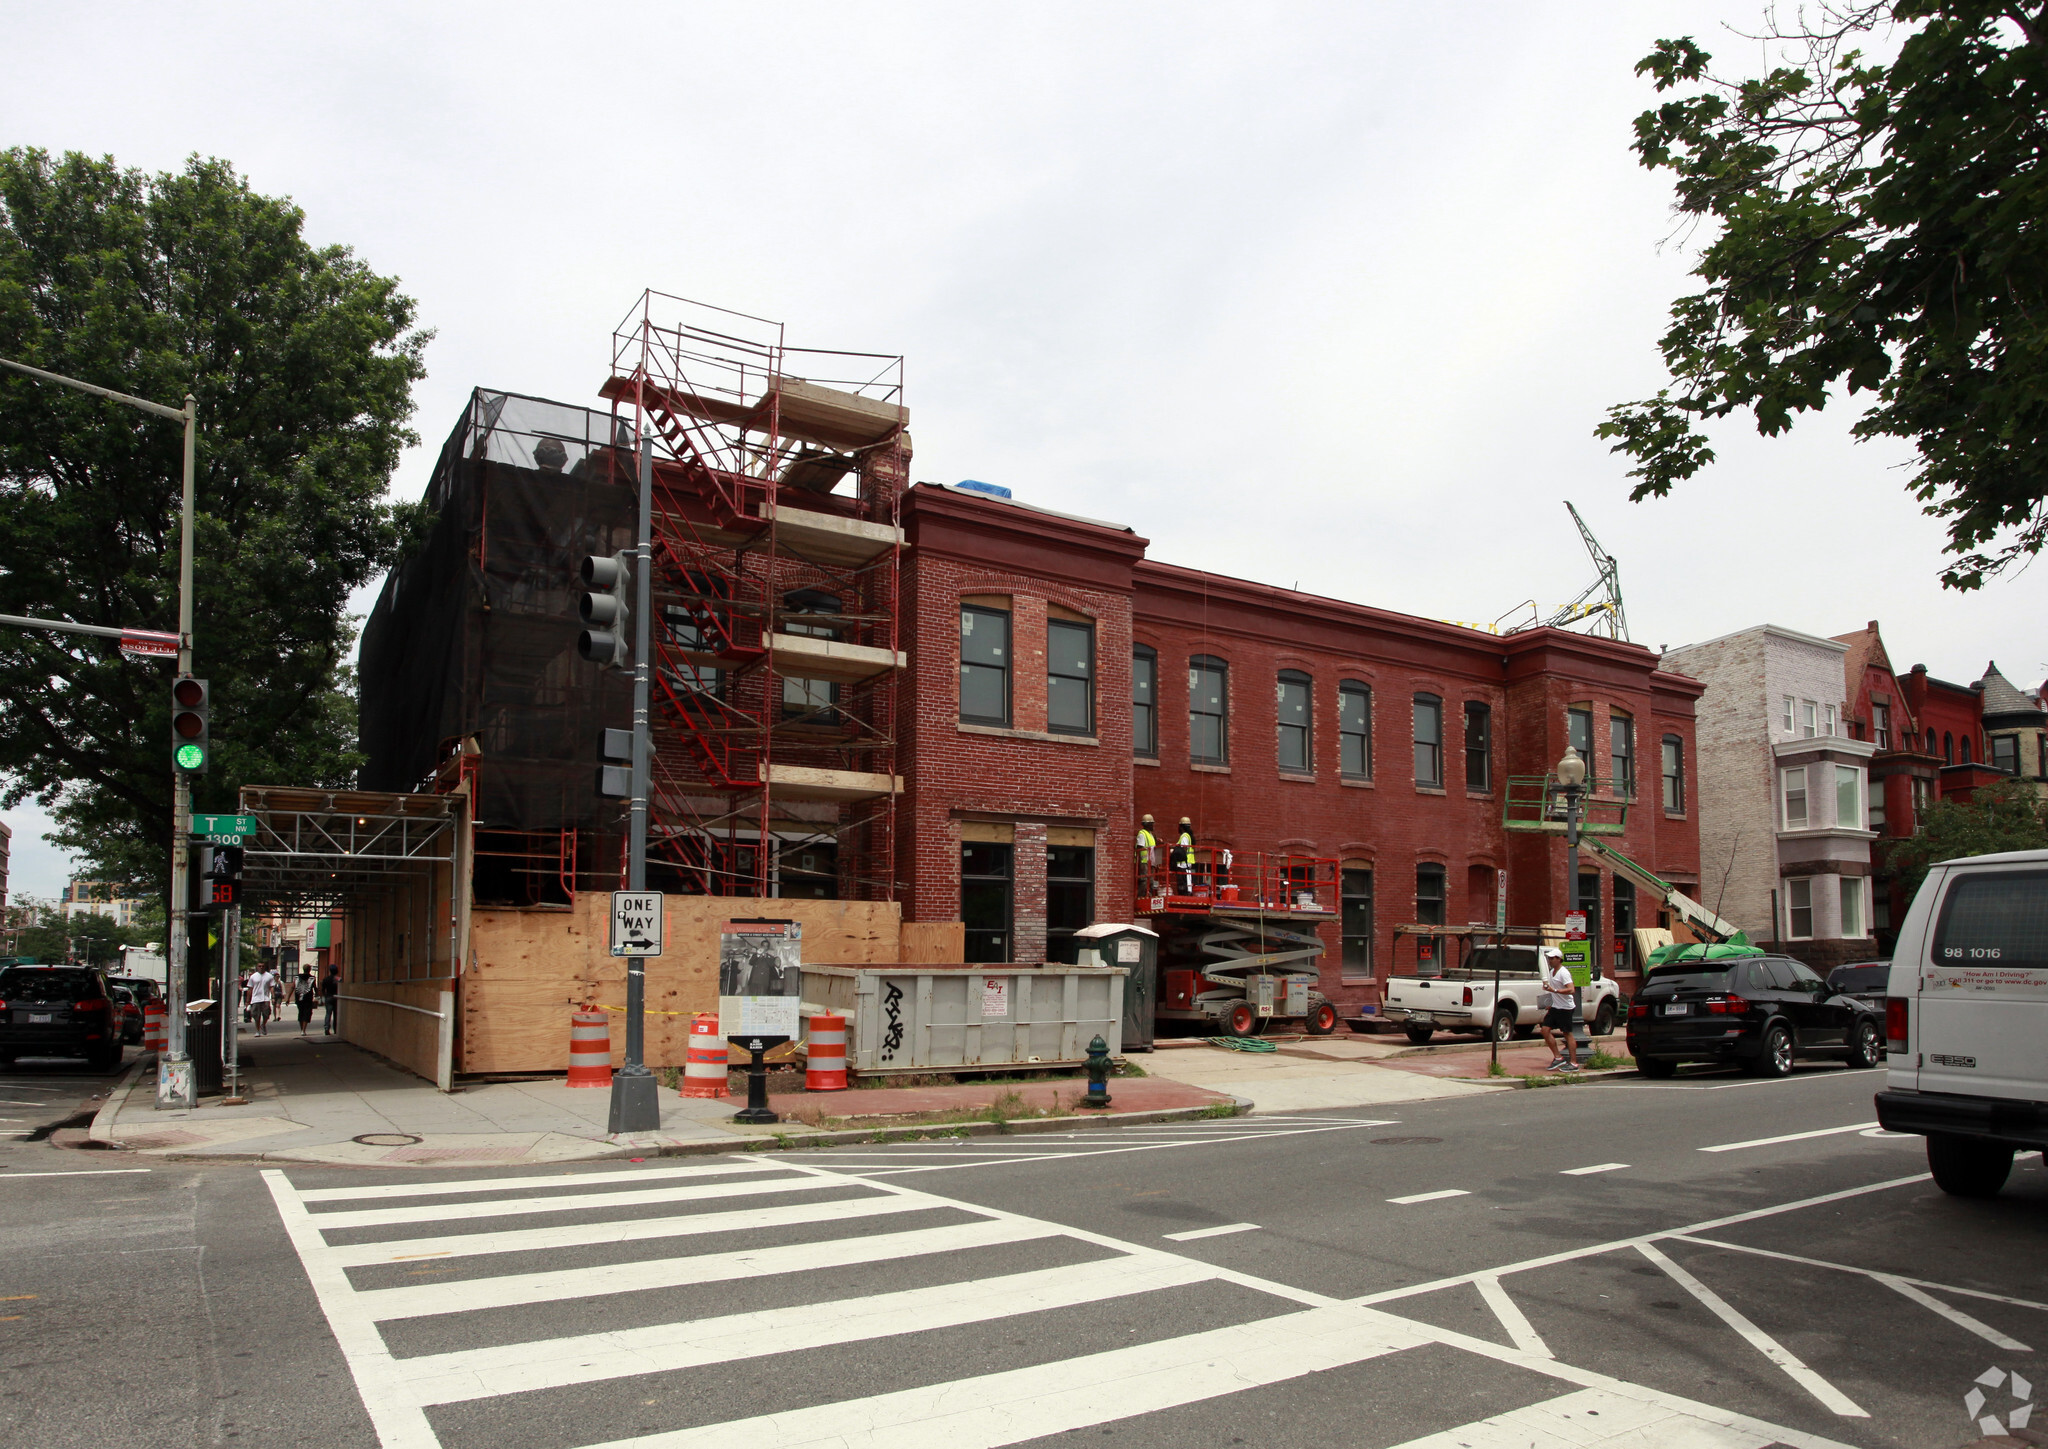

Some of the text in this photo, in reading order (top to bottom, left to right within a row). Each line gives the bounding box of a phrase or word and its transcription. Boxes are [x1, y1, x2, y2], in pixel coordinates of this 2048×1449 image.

[122, 643, 148, 651] ROSS
[151, 646, 176, 654] PETE
[205, 817, 247, 832] T ST
[206, 834, 240, 845] 1300
[623, 899, 653, 911] ONE
[623, 917, 653, 929] WAY
[1944, 948, 2001, 959] 98 1016
[1931, 1054, 1976, 1066] E350
